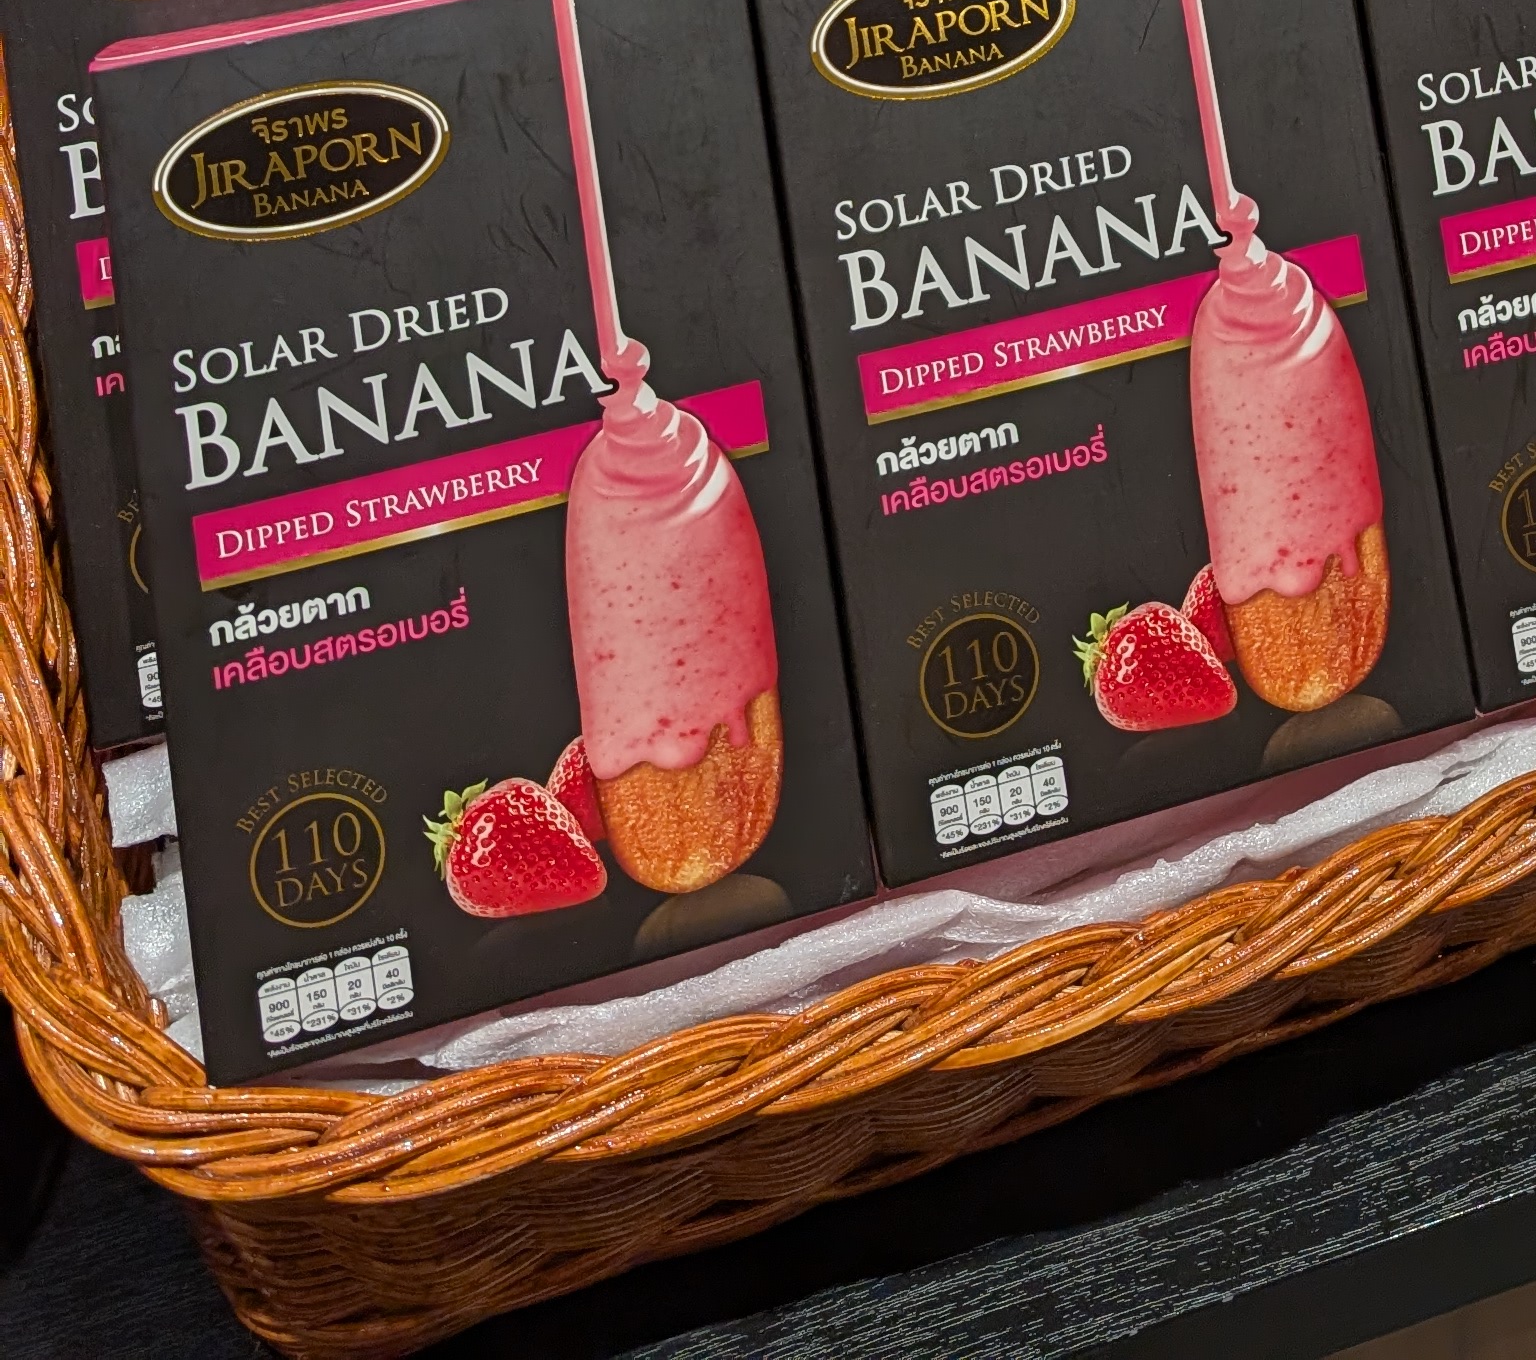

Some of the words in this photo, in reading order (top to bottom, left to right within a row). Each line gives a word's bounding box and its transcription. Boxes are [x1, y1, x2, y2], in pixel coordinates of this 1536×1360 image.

[833, 179, 982, 242] SOLAR
[989, 142, 1134, 207] DRIED
[172, 326, 338, 395] SOLAR
[347, 285, 511, 355] DRIED
[876, 421, 1020, 478] กล้วยตาก
[880, 423, 1110, 518] เคลือบสตรอเบอรี่
[937, 630, 1019, 690] 110
